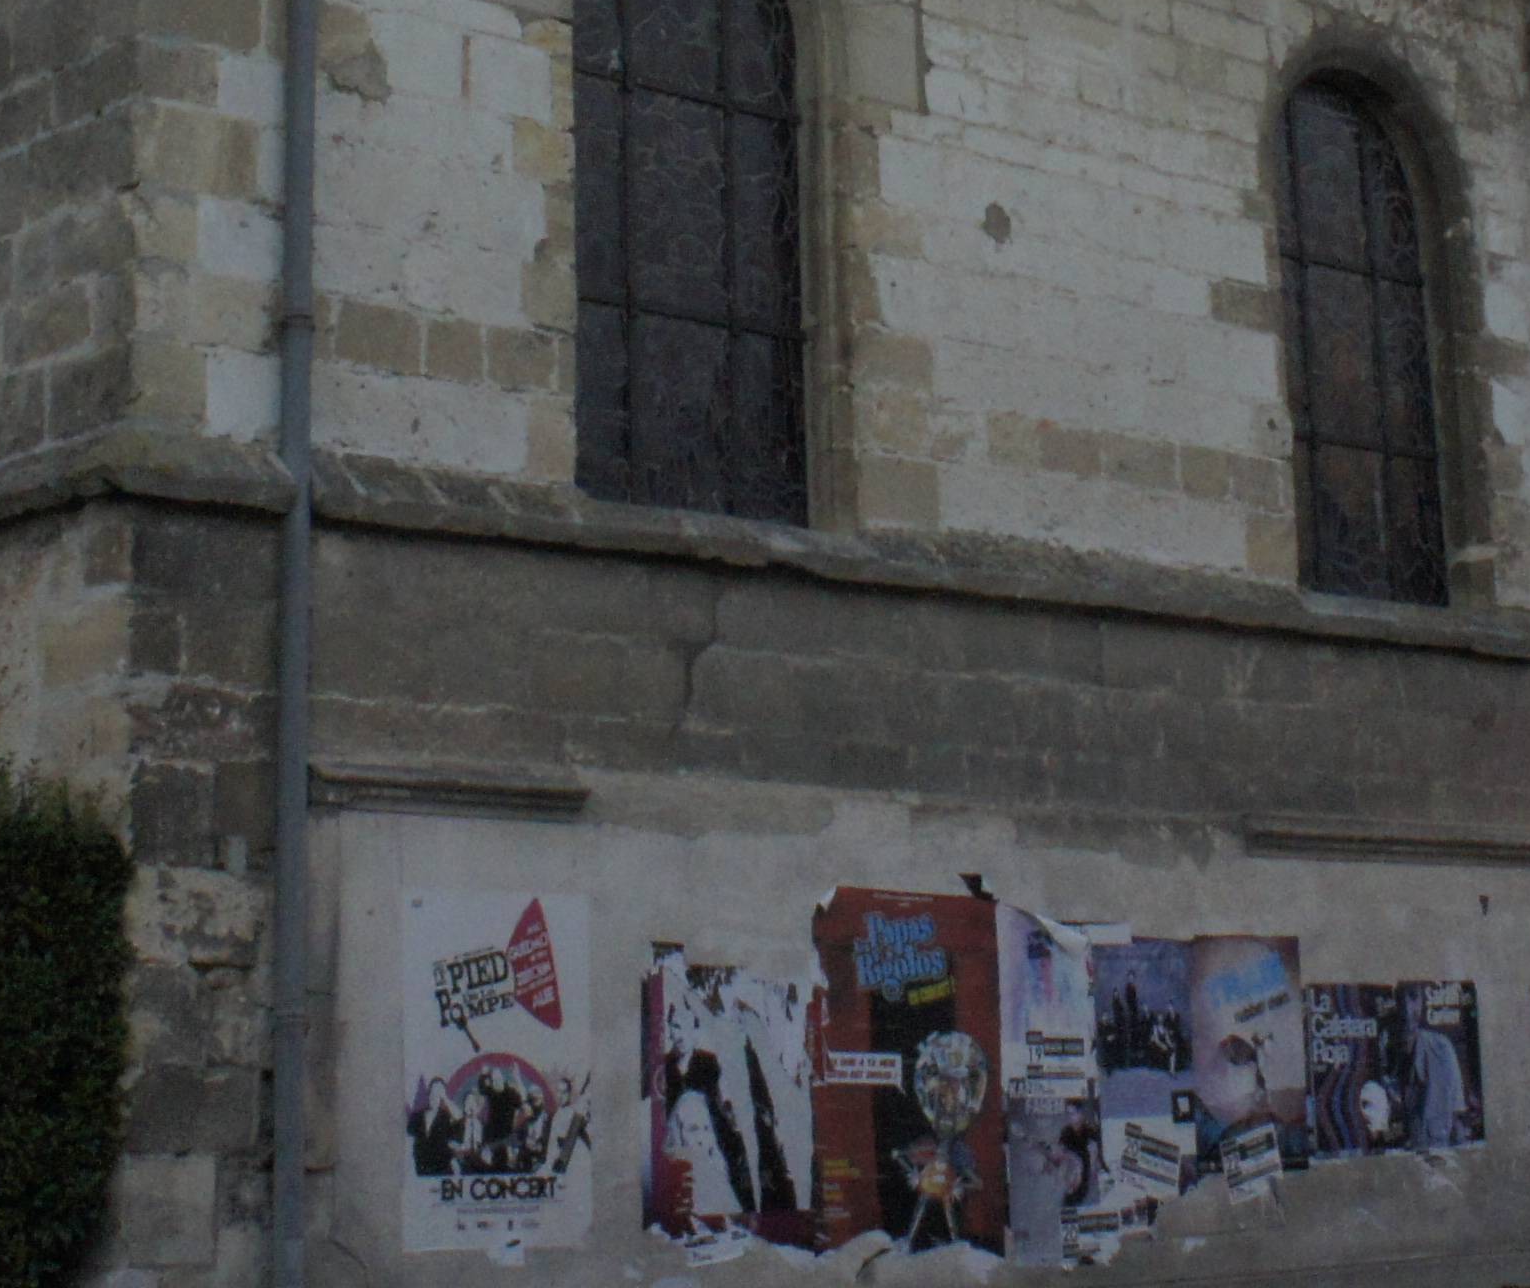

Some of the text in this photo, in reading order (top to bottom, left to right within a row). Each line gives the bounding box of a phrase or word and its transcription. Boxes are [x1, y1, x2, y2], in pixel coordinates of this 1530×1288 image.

[447, 951, 509, 995] PIED
[1310, 989, 1331, 1013] La
[1312, 1012, 1378, 1039] Cafetera
[441, 1176, 557, 1201] EN CONCERT
